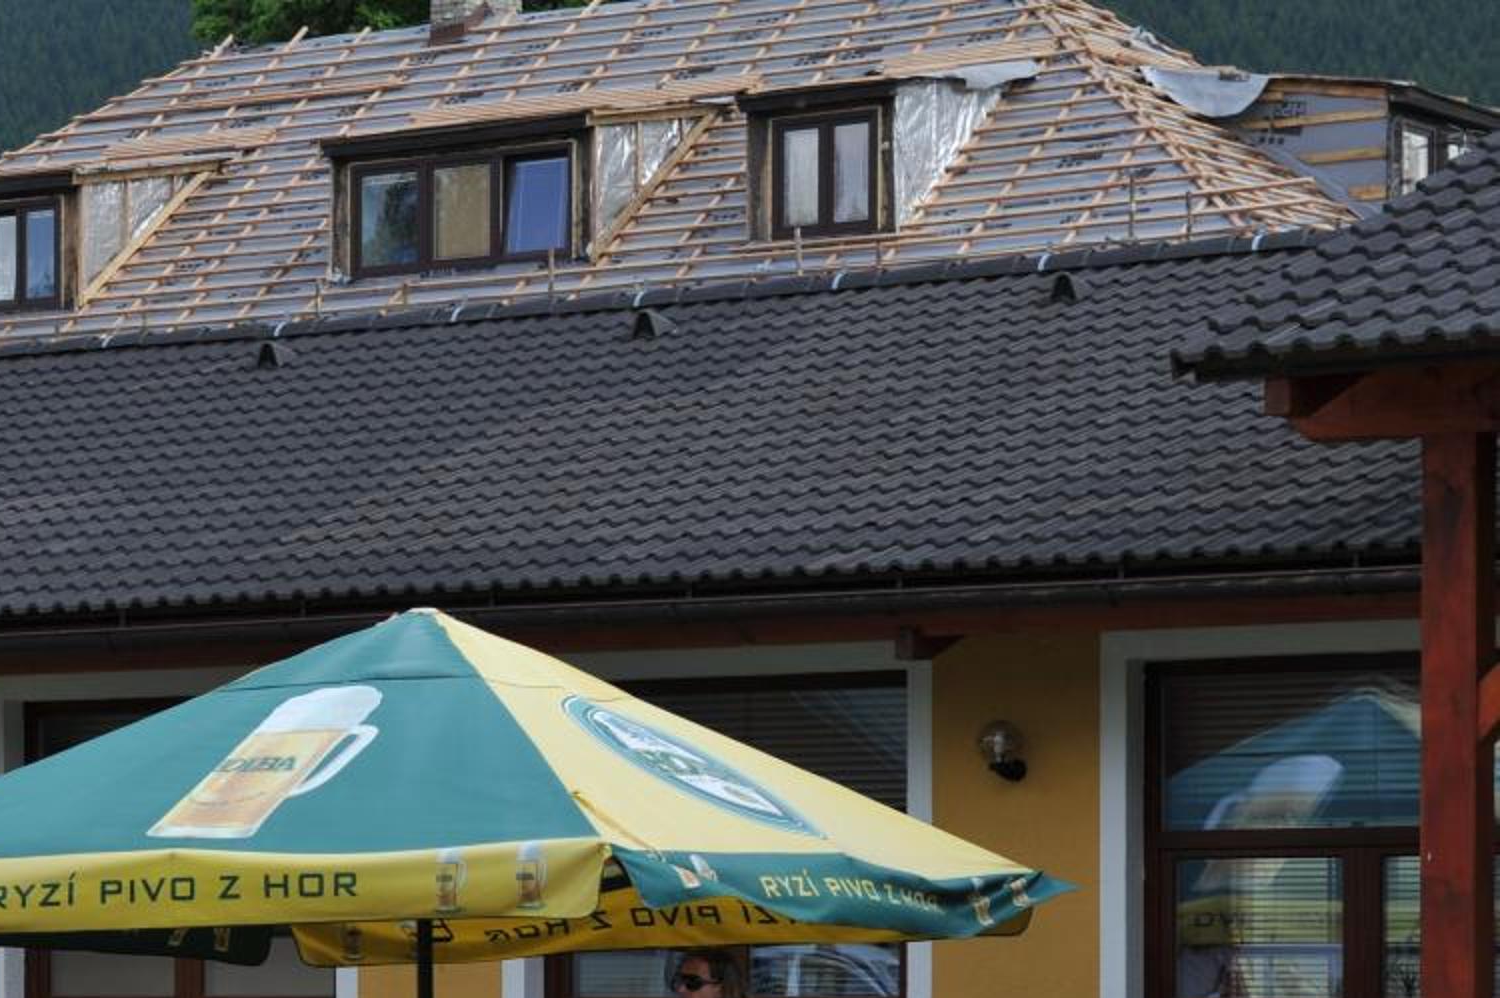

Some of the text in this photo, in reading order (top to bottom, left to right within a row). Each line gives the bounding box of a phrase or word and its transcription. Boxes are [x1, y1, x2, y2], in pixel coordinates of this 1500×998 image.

[100, 876, 196, 904] PIVO
[219, 875, 240, 900] Z
[263, 872, 358, 899] HOR
